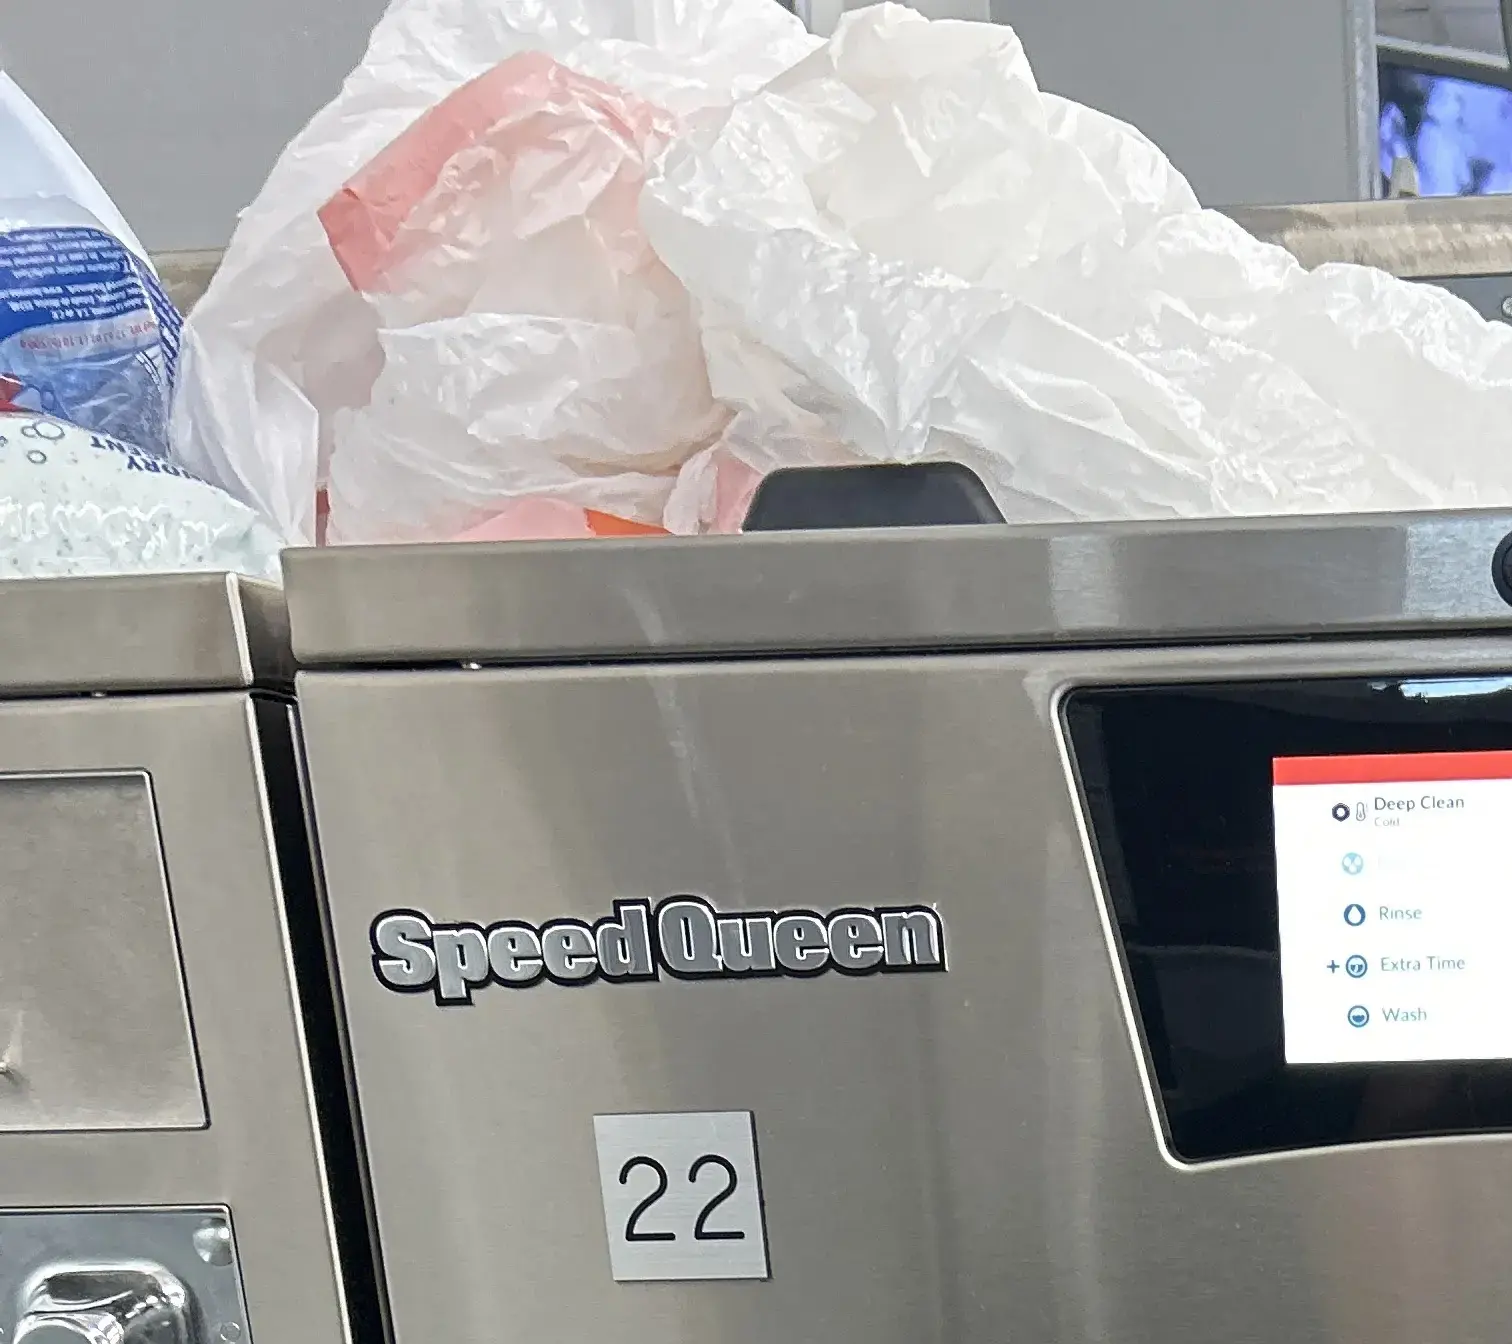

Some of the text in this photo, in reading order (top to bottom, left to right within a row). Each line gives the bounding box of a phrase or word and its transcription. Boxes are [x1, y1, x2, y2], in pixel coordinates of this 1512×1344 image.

[1374, 796, 1465, 812] Deep Clean
[1379, 906, 1422, 920] Rinse
[1380, 956, 1466, 972] Extra Time
[1382, 1007, 1427, 1022] Wash
[618, 1154, 745, 1242] 22
